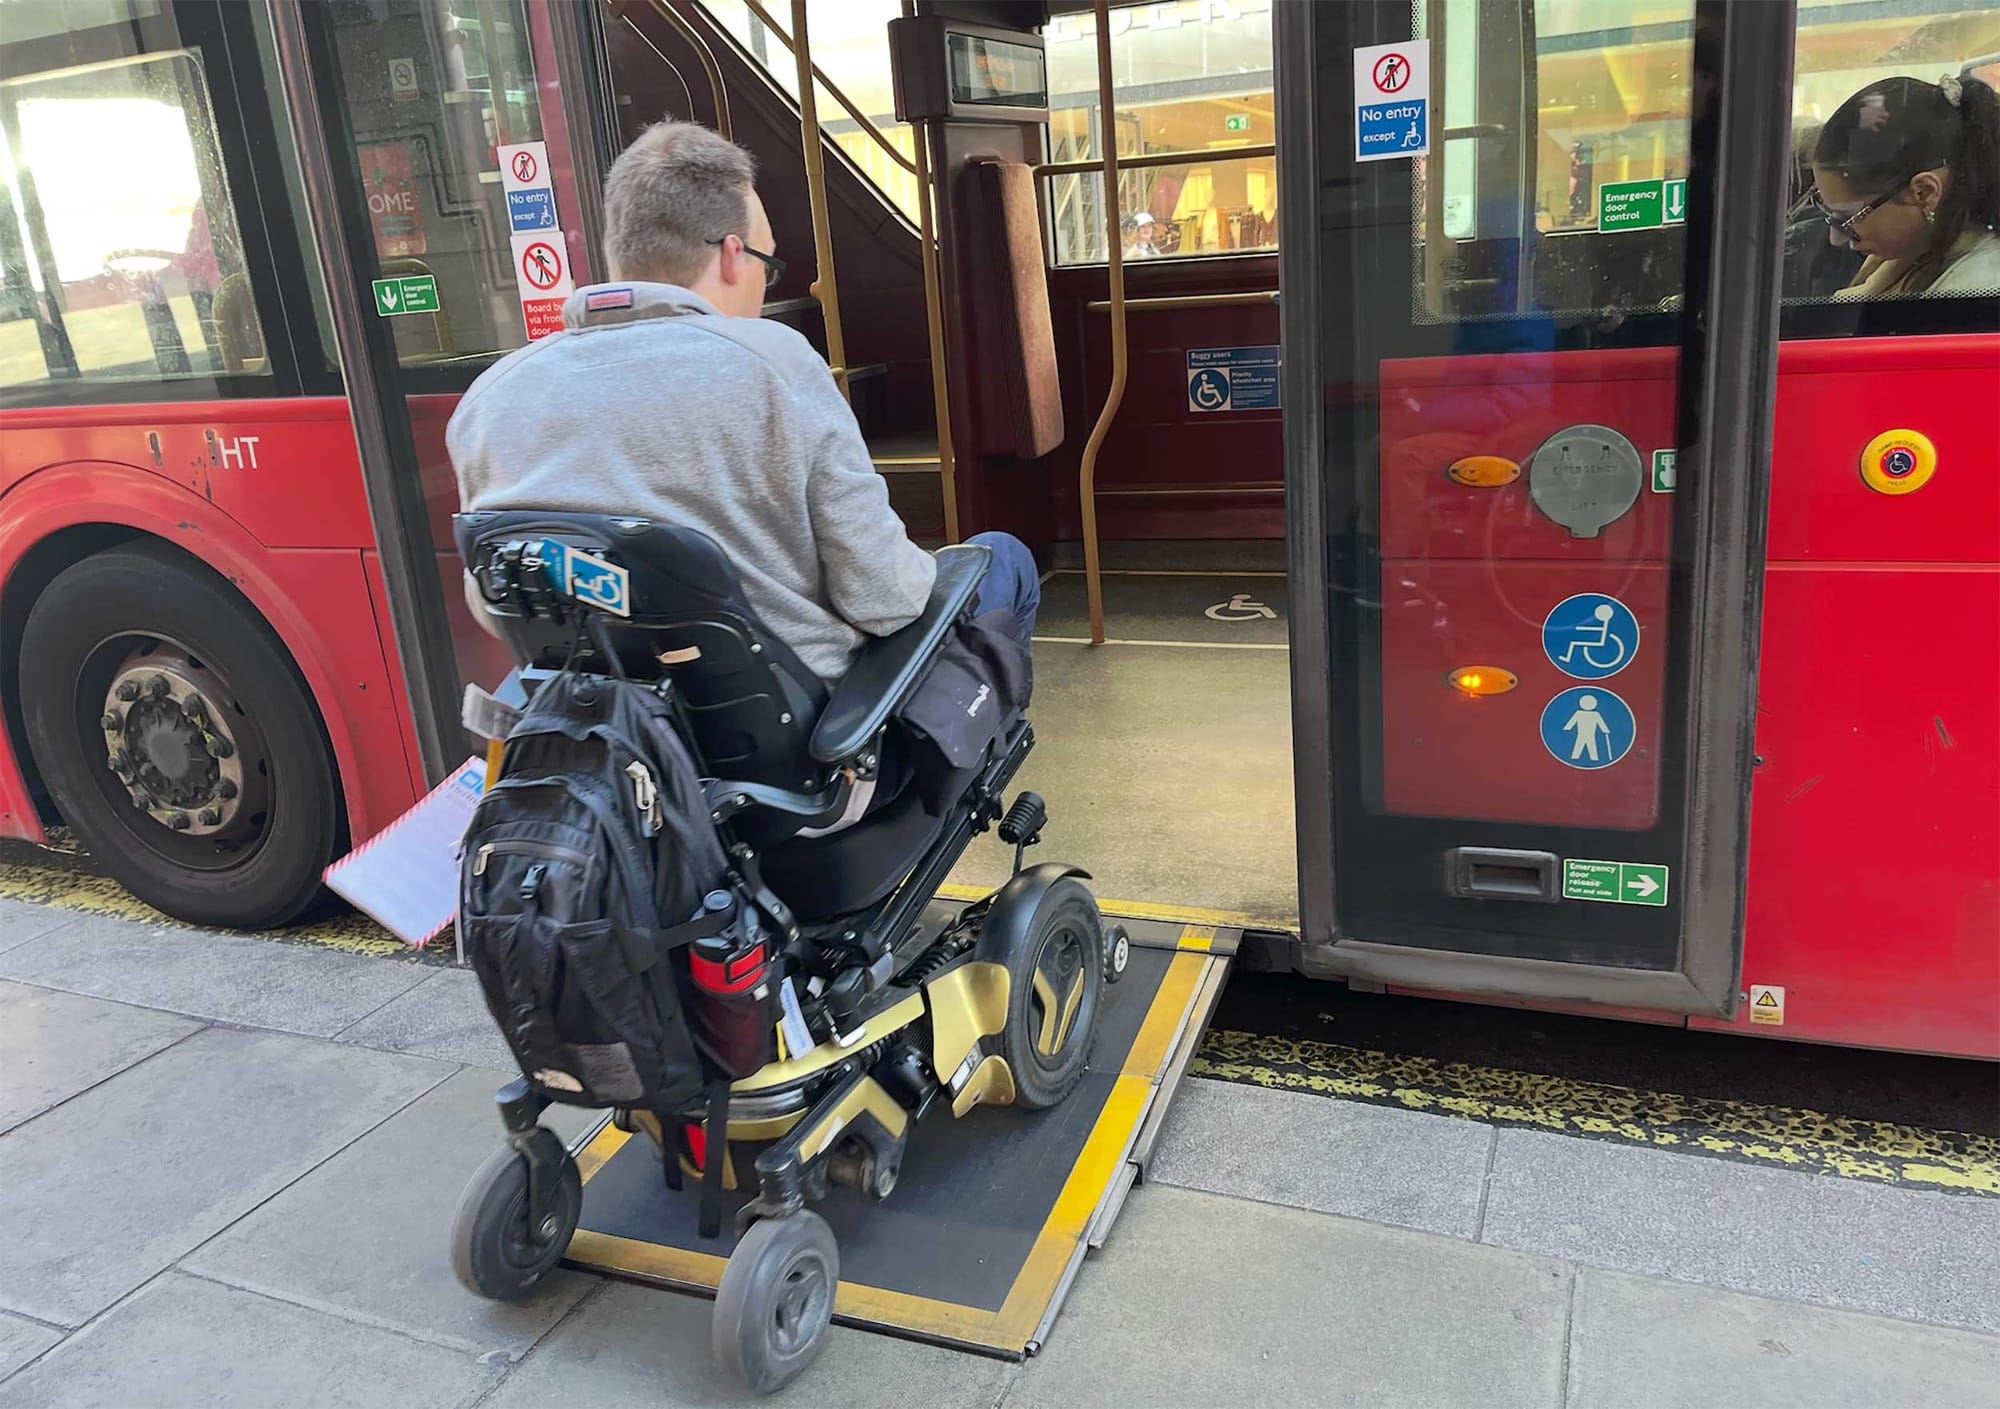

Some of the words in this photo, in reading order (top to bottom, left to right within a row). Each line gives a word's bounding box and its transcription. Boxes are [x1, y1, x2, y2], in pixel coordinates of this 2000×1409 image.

[1362, 109, 1382, 122] No
[1385, 106, 1421, 119] entry
[1363, 131, 1396, 143] except
[510, 194, 524, 204] No
[525, 193, 548, 204] entry
[1605, 191, 1657, 202] Emergency
[1605, 203, 1627, 212] door
[513, 212, 536, 221] except
[1605, 211, 1640, 222] control
[403, 284, 432, 292] Emergency
[406, 298, 426, 306] control
[527, 302, 551, 313] Board
[529, 315, 541, 324] via
[531, 326, 551, 336] door
[1191, 352, 1211, 360] Buggy
[219, 436, 259, 469] HT
[1569, 863, 1617, 874] Emergency
[1569, 879, 1600, 887] release
